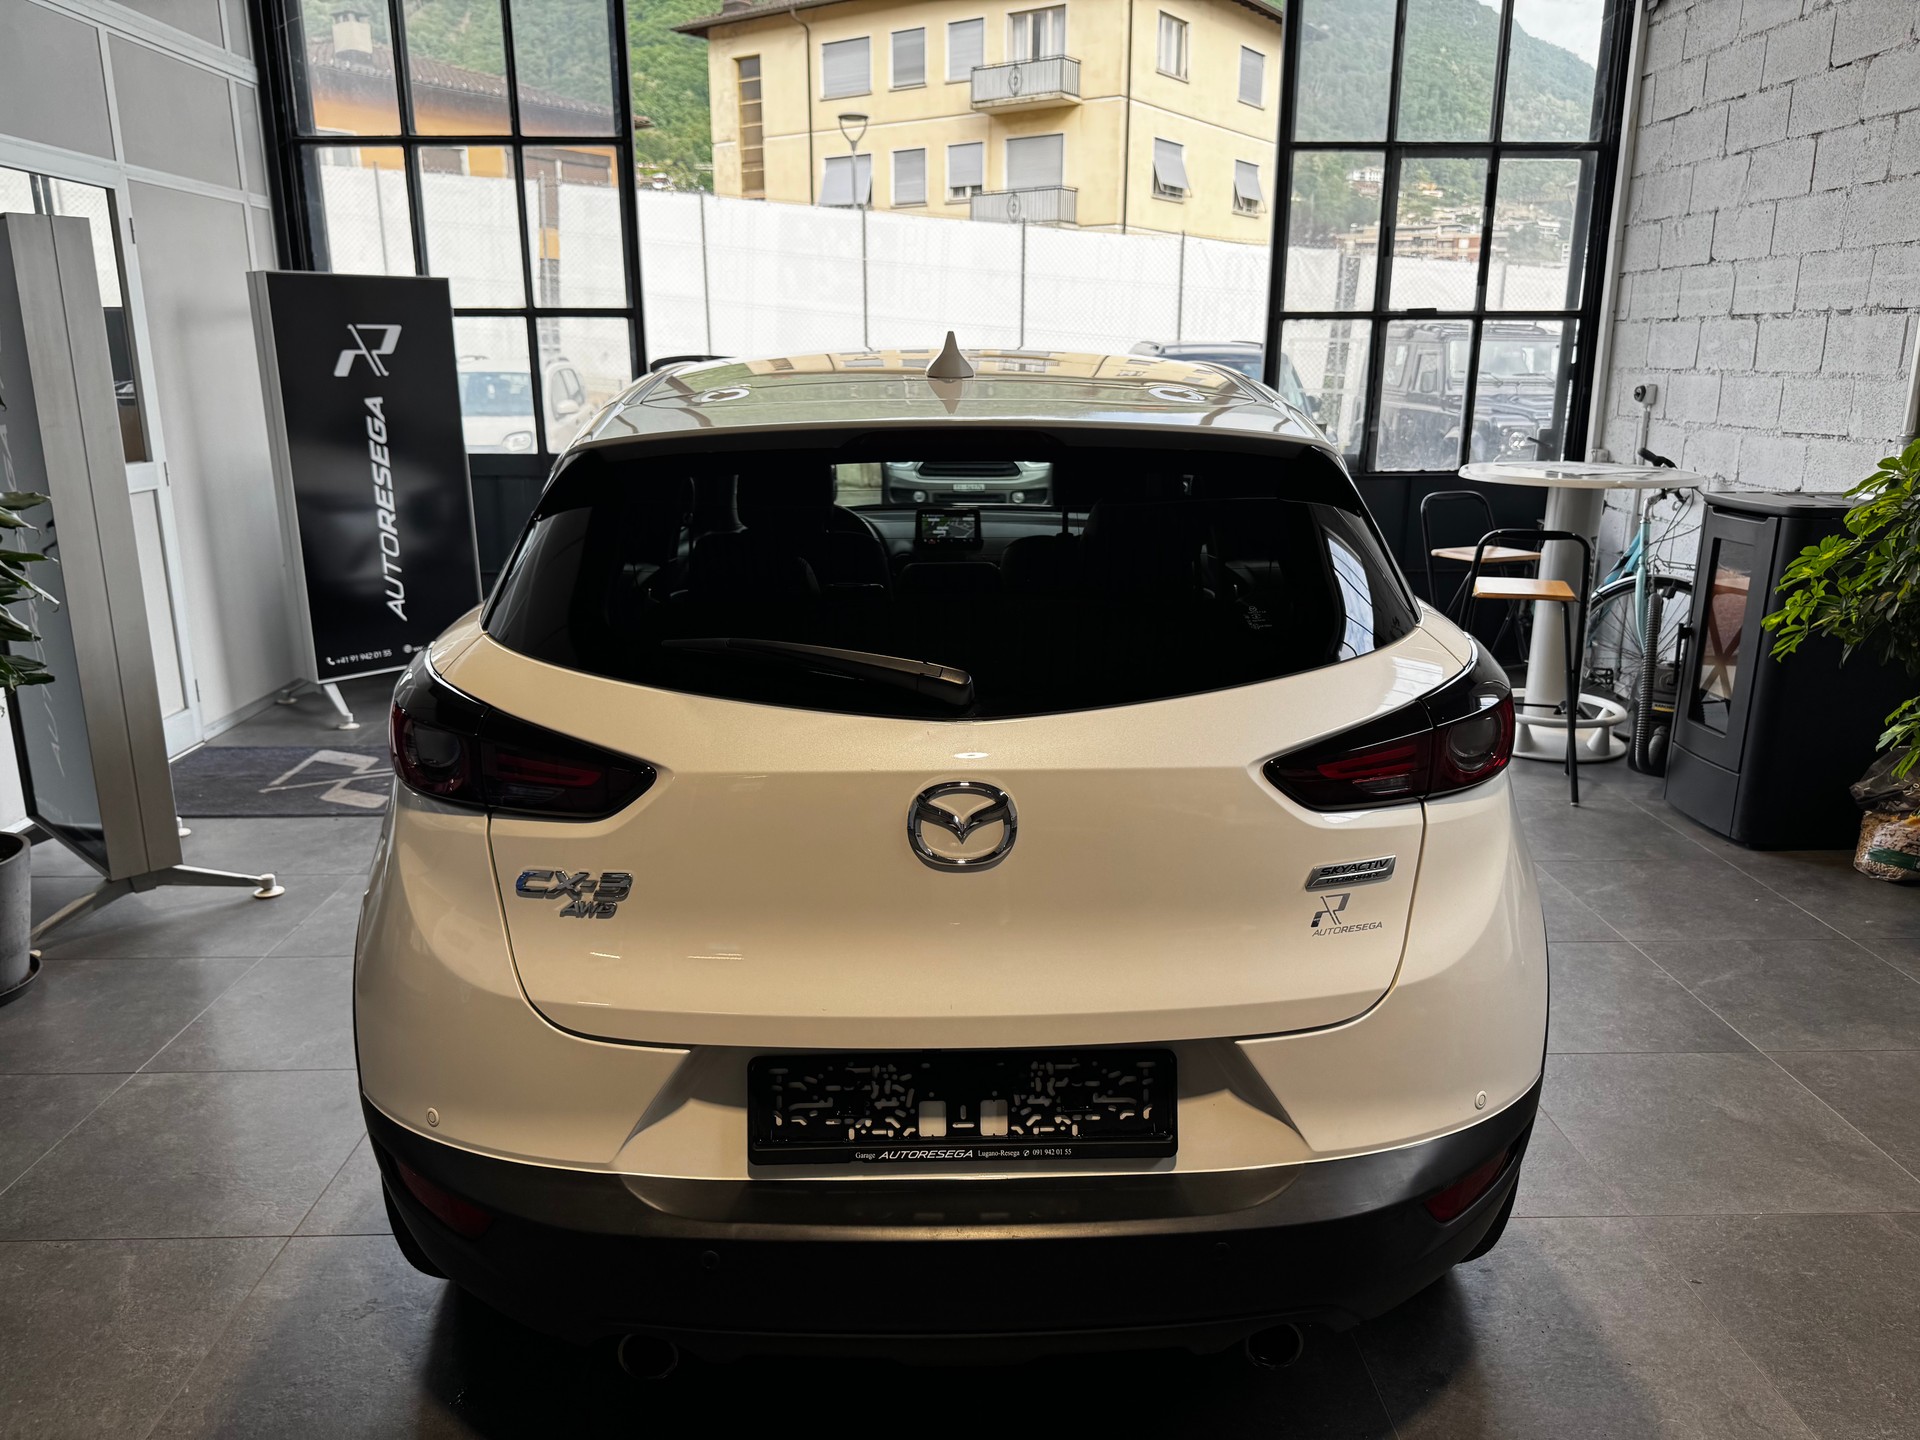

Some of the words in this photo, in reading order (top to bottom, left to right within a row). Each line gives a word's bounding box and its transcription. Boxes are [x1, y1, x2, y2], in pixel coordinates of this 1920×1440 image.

[364, 396, 408, 622] AUTORESEGA
[1320, 859, 1389, 877] SKYACTIV
[515, 869, 633, 902] CX-3
[559, 900, 618, 919] AWD
[1311, 921, 1383, 937] AUTORESEGA
[855, 1151, 876, 1160] Garage
[878, 1149, 973, 1160] AUTORESEGA
[977, 1149, 1020, 1158] Lugano-Resega
[1032, 1148, 1043, 1156] 091
[1044, 1148, 1055, 1156] 942
